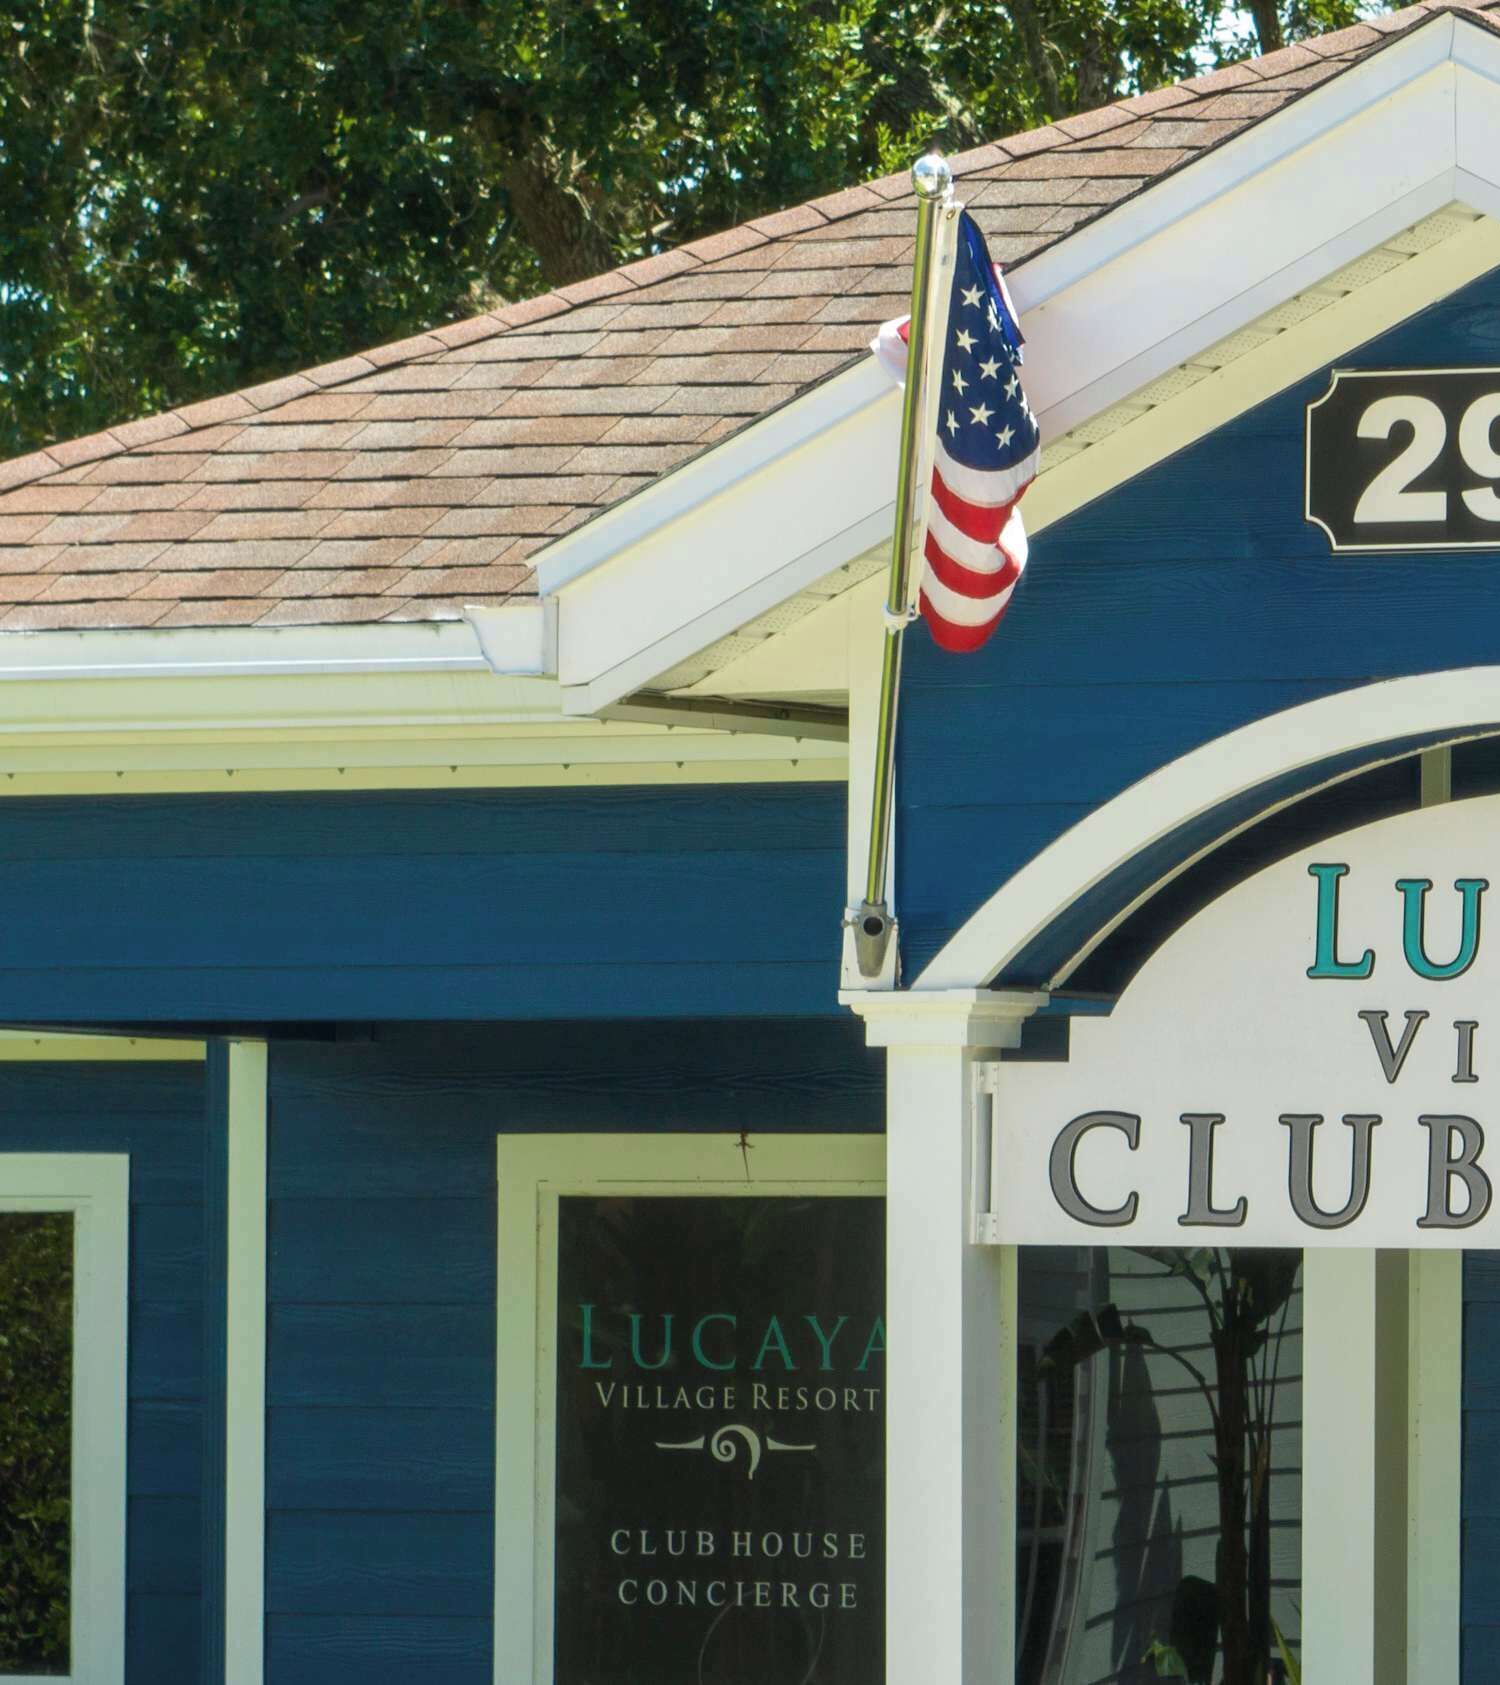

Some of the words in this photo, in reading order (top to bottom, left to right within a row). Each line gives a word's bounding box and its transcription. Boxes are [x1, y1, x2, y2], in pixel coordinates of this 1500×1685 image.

[578, 1304, 886, 1371] LUCAYA
[595, 1382, 736, 1410] VILLAGE
[752, 1382, 881, 1412] RESORT
[618, 1578, 858, 1609] CONCIERGE
